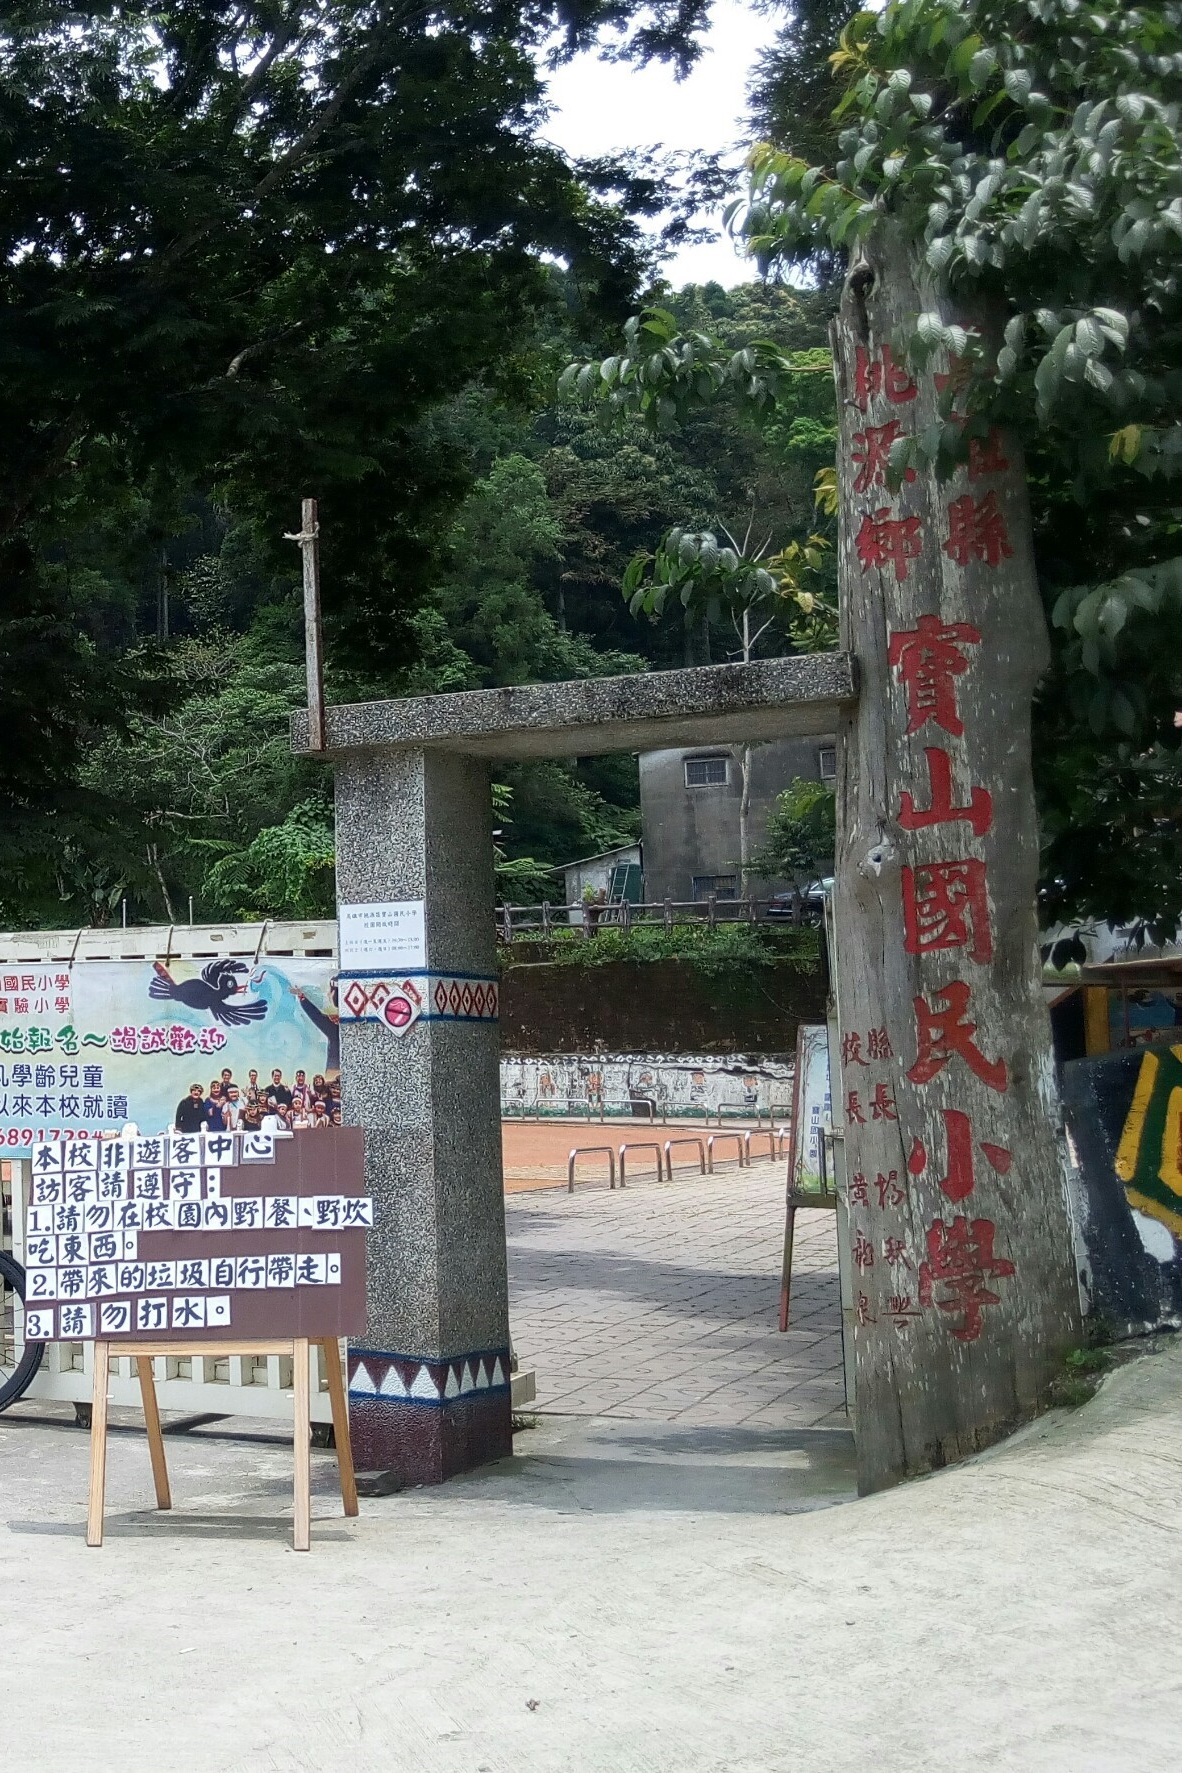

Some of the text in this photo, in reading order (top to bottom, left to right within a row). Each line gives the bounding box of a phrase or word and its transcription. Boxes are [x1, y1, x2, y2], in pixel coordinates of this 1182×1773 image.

[888, 614, 1015, 1342] 寶山國民小學
[33, 1133, 273, 1170] 本校非遊客中心
[28, 1234, 135, 1265] 吃東西。
[31, 1255, 340, 1298] 2.帶來的垃圾自行帶走。
[27, 1298, 226, 1338] 3.請勿打水。
